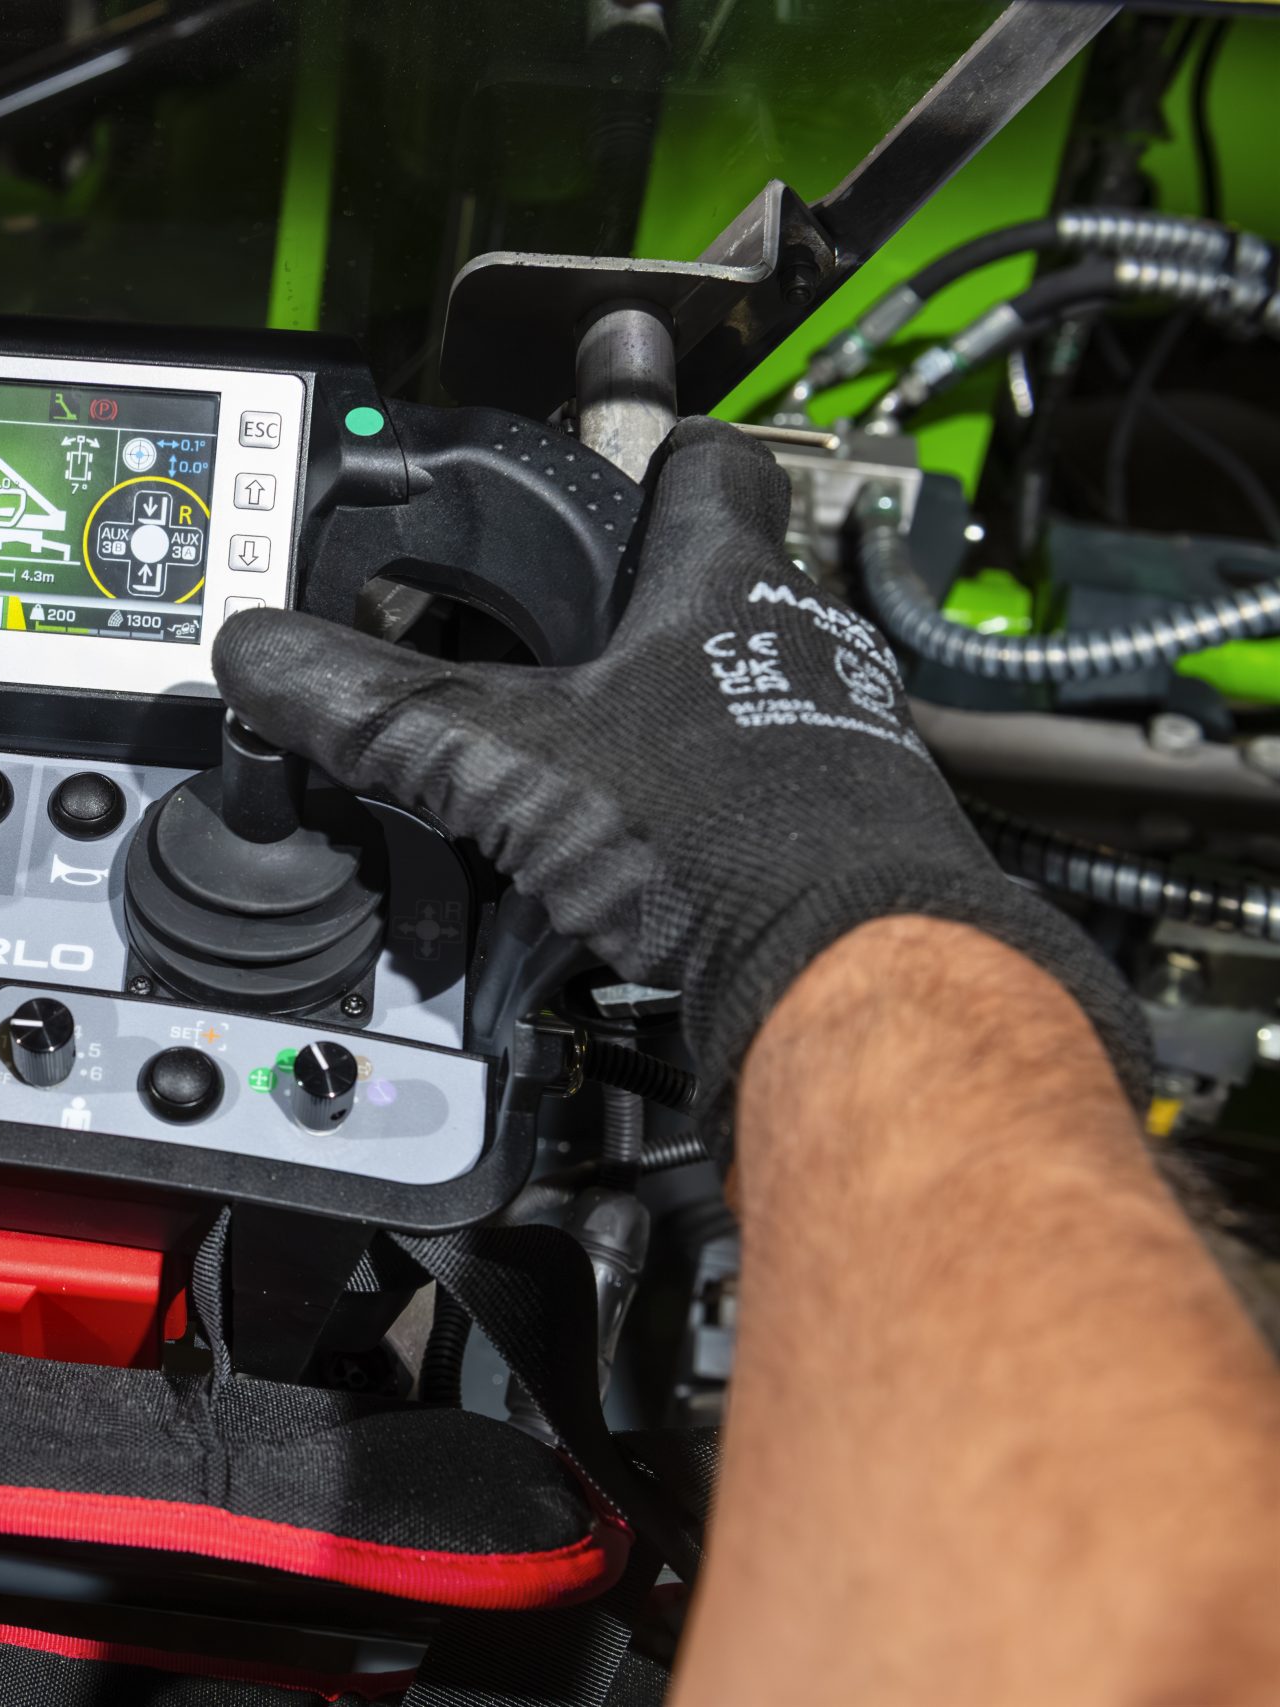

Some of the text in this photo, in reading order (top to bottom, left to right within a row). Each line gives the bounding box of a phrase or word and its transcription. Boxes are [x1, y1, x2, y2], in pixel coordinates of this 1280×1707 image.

[243, 421, 278, 439] ESC
[180, 439, 206, 452] 0.1°
[179, 461, 209, 474] 0.0°
[179, 505, 193, 525] R
[101, 527, 130, 541] AUX
[171, 532, 200, 546] AUX
[21, 570, 55, 583] 4.3m
[47, 609, 76, 622] 200
[126, 614, 162, 629] 1300
[703, 631, 778, 657] CE
[170, 1026, 203, 1041] SET
[88, 1043, 101, 1058] 5
[90, 1066, 103, 1081] 6
